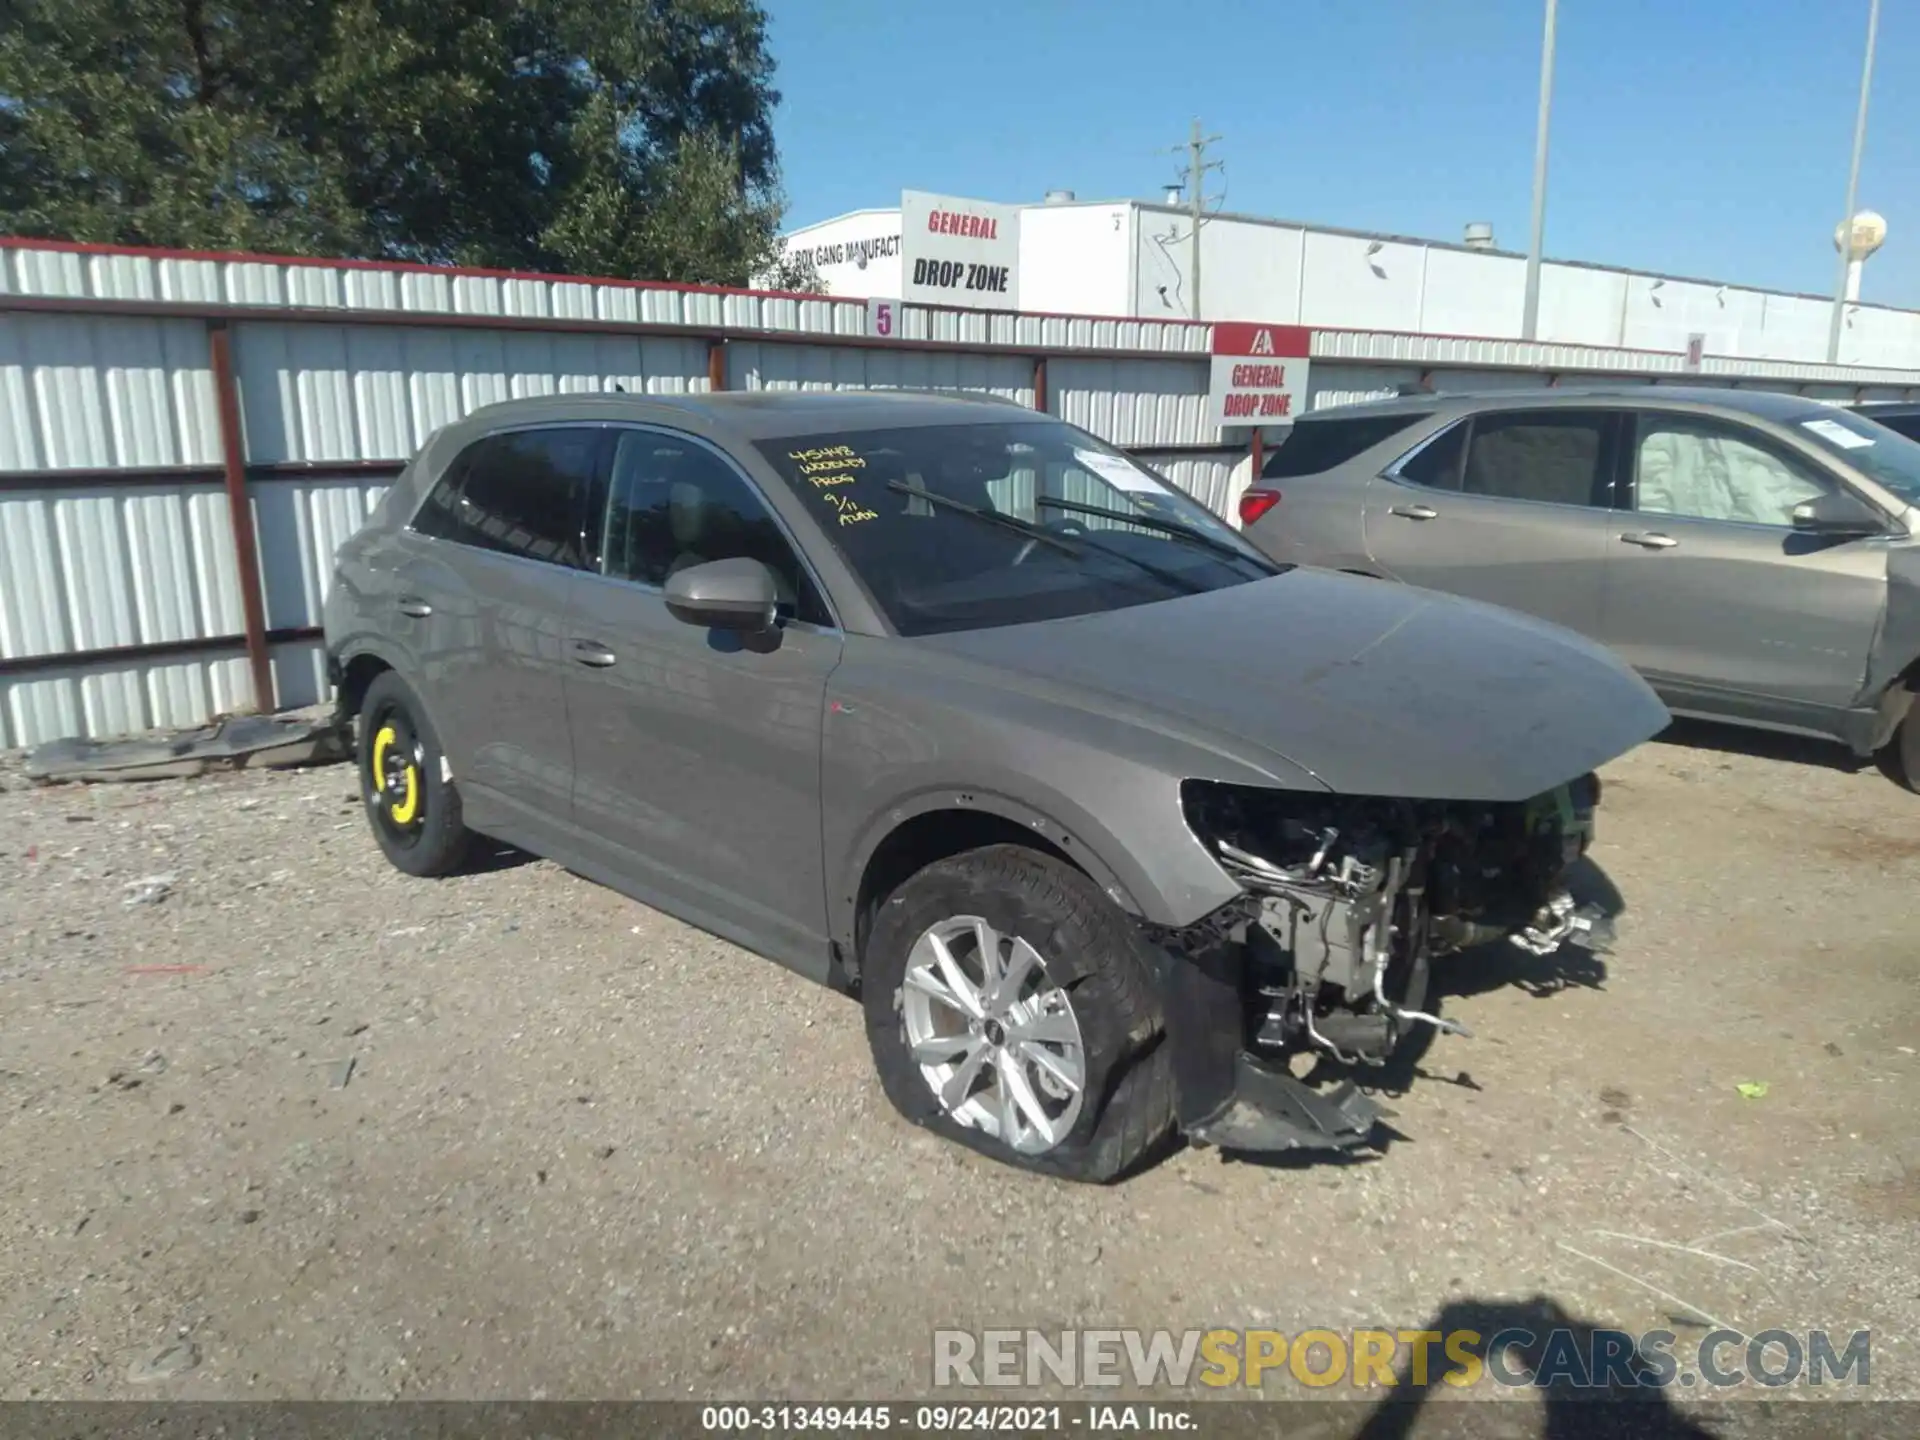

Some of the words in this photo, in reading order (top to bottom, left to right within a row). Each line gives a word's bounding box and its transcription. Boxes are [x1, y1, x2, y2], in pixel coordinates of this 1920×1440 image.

[928, 210, 998, 239] GENERAL
[816, 243, 843, 267] GANG
[845, 234, 903, 263] MANUFACT
[913, 257, 964, 289] DROP
[966, 263, 1009, 292] ZONE
[877, 303, 892, 336] 5
[1232, 364, 1285, 388] GENERAL
[1224, 393, 1259, 417] DROP
[1260, 393, 1292, 417] ZONE
